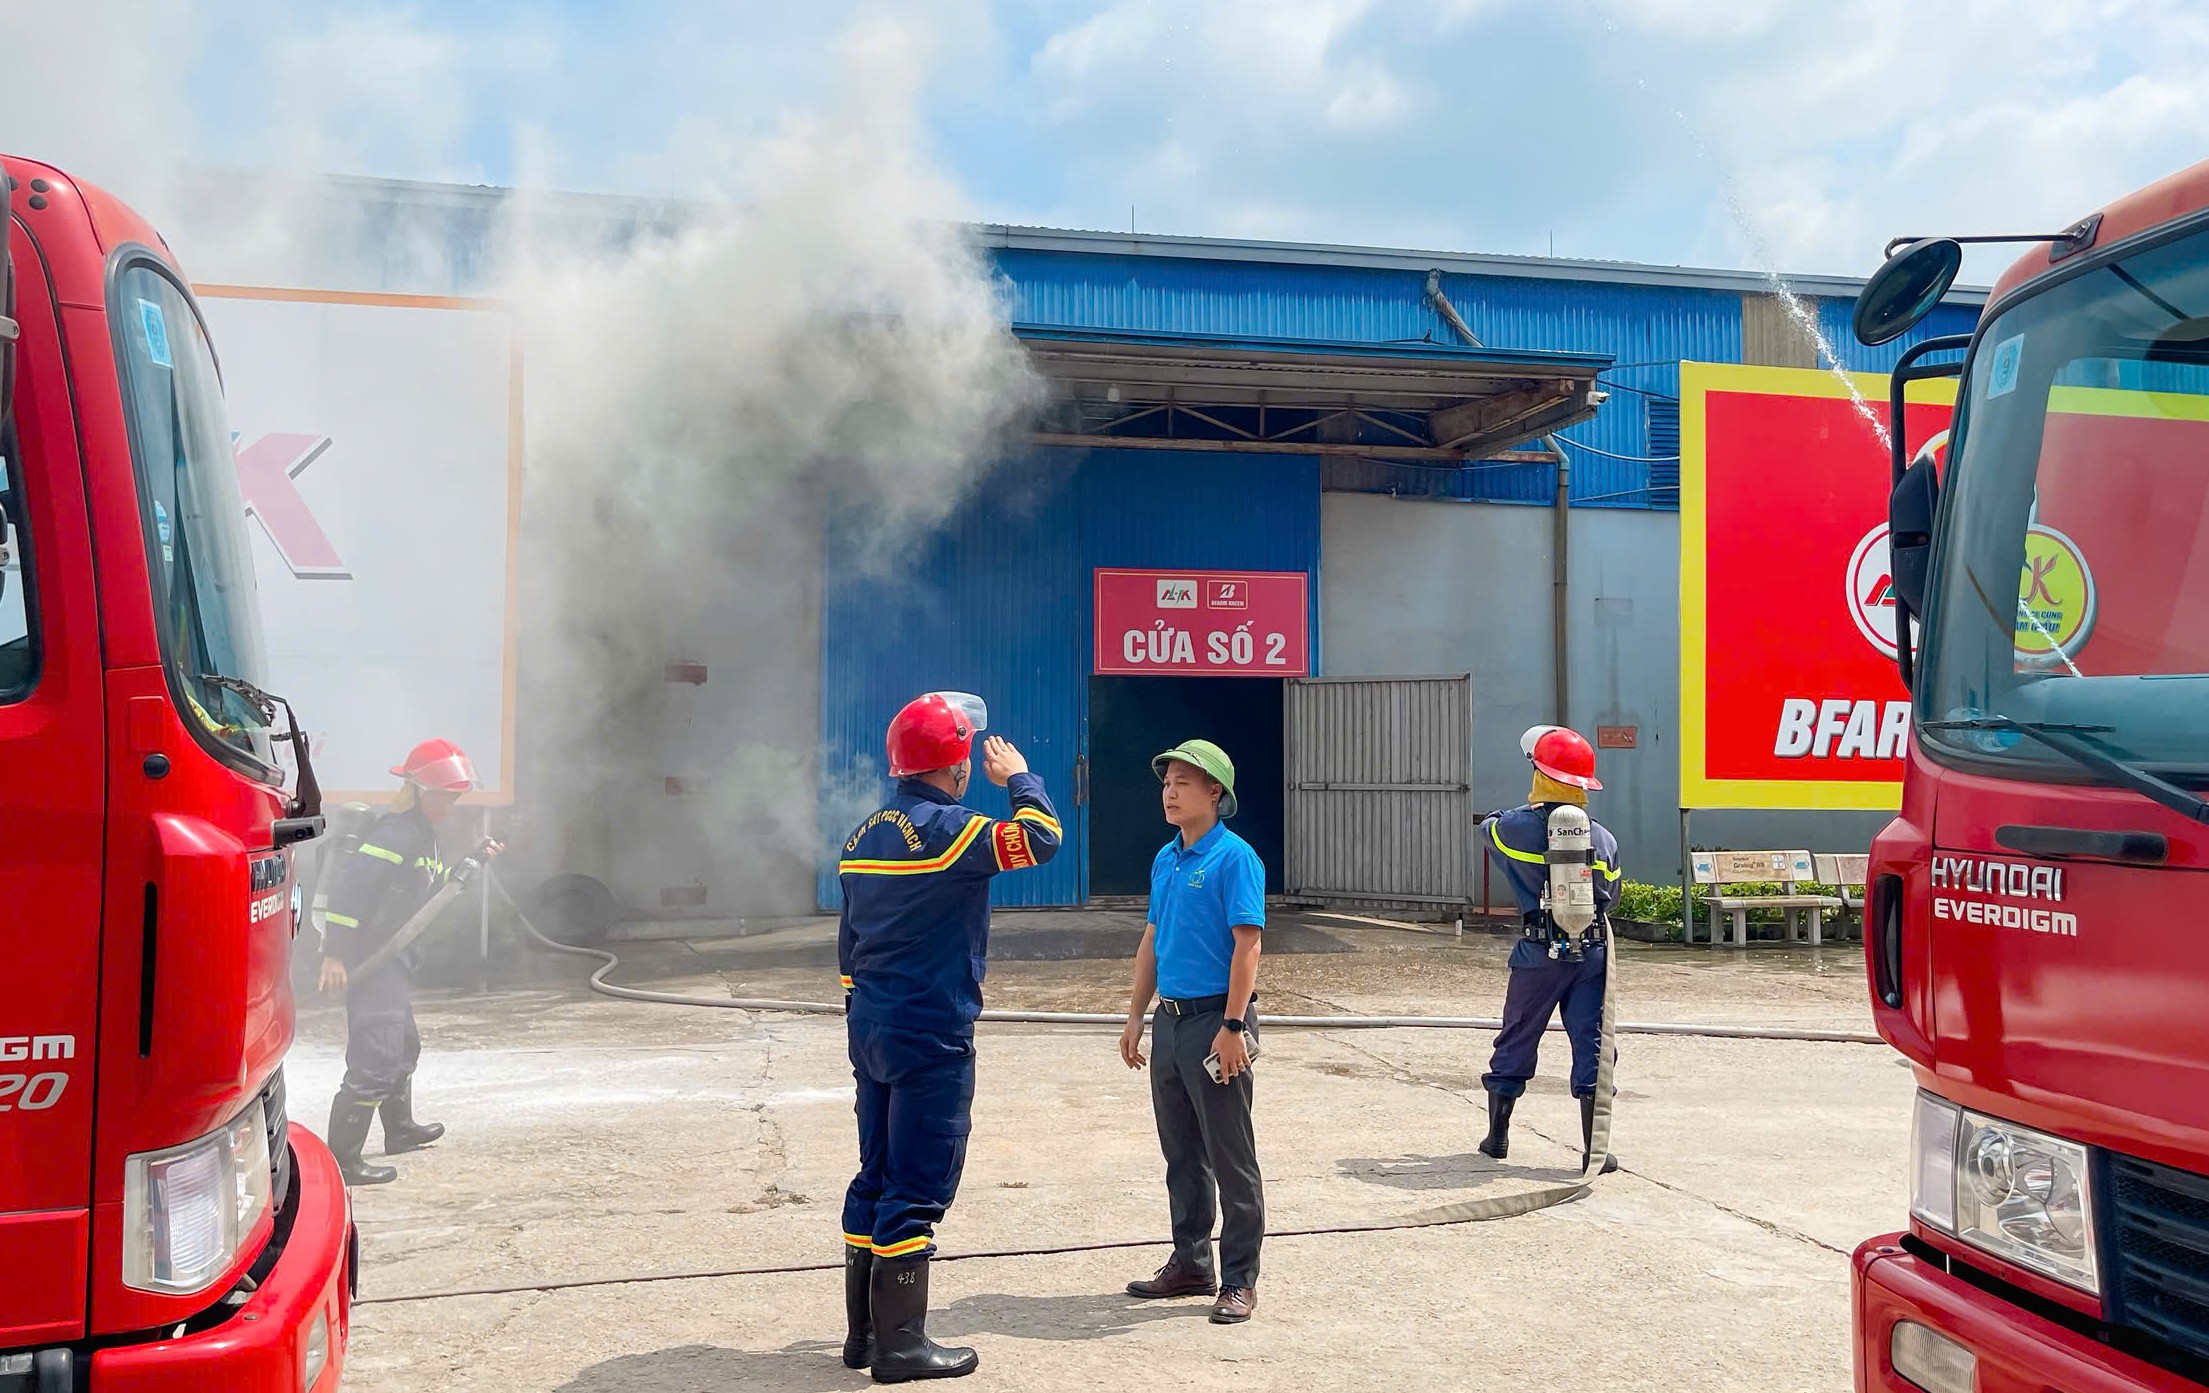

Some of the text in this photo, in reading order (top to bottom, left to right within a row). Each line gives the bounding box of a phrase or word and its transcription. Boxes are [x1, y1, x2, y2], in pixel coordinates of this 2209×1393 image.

[1123, 619, 1286, 664] CỬA SỐ 2
[1931, 857, 2063, 901] HYUNDAI
[1934, 897, 2077, 936] EVERDIGM
[897, 1271, 915, 1285] 438
